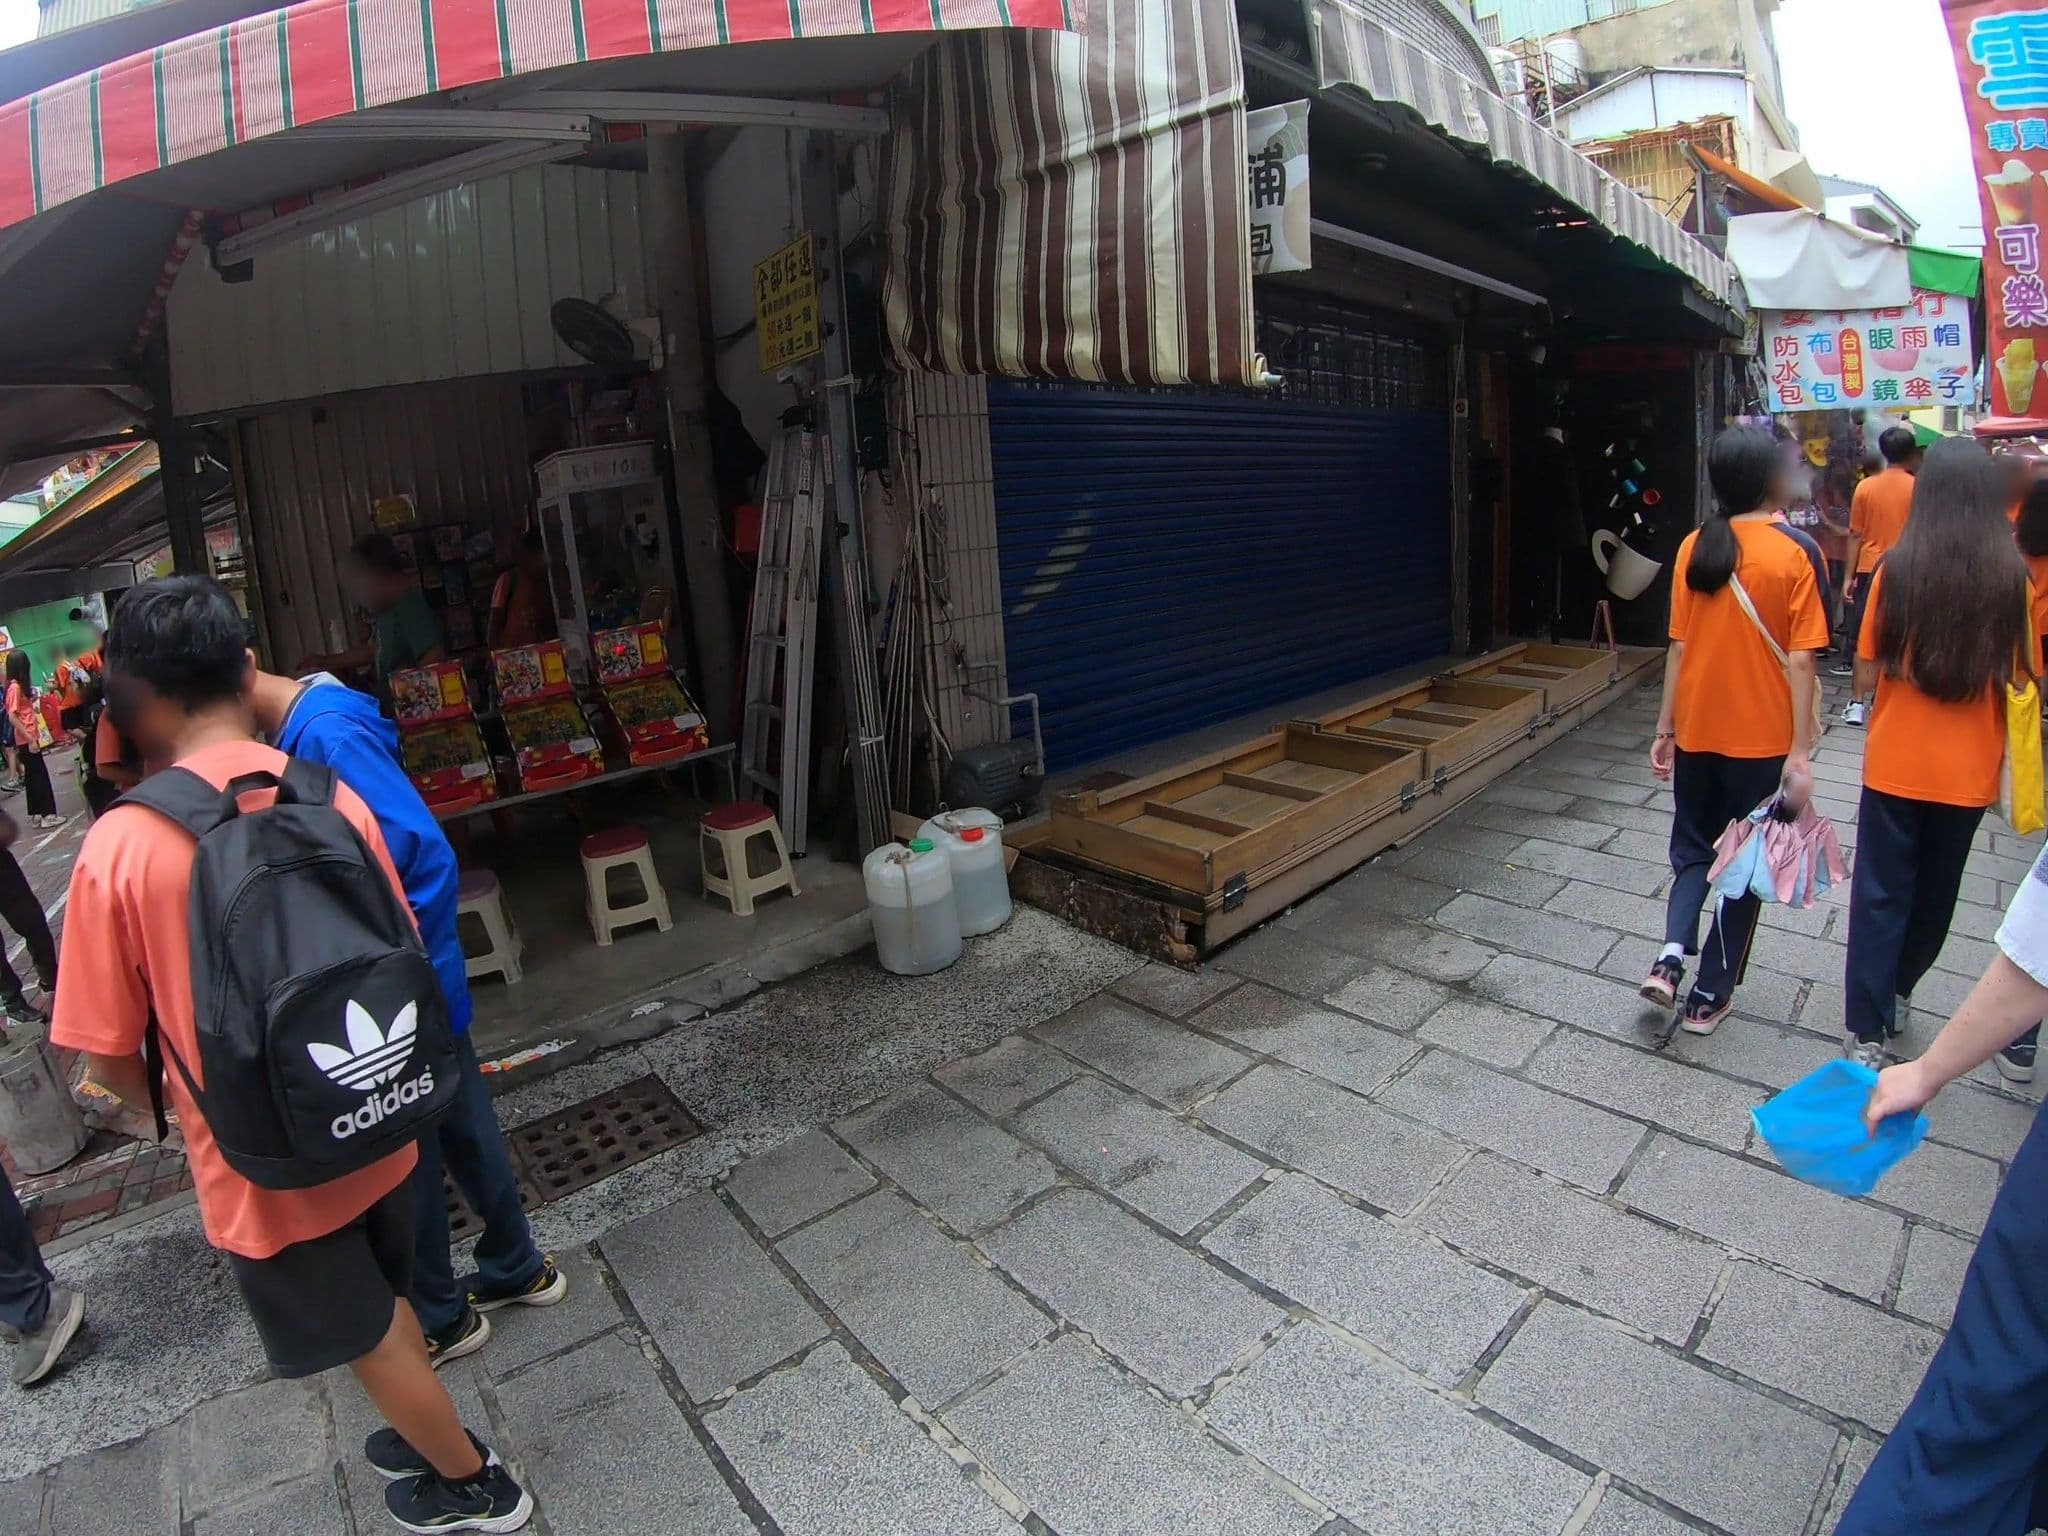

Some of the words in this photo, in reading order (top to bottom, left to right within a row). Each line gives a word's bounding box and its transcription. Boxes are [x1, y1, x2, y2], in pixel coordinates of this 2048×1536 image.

[1985, 117, 2048, 151] 專賣
[1995, 224, 2048, 327] 可樂
[1773, 336, 1804, 405] 防水包
[1807, 332, 1838, 403] 布包
[1868, 328, 1899, 401] 眼鏡
[1900, 326, 1933, 399] 雨傘
[1934, 324, 1964, 399] 帽子
[331, 1071, 435, 1139] adidas
